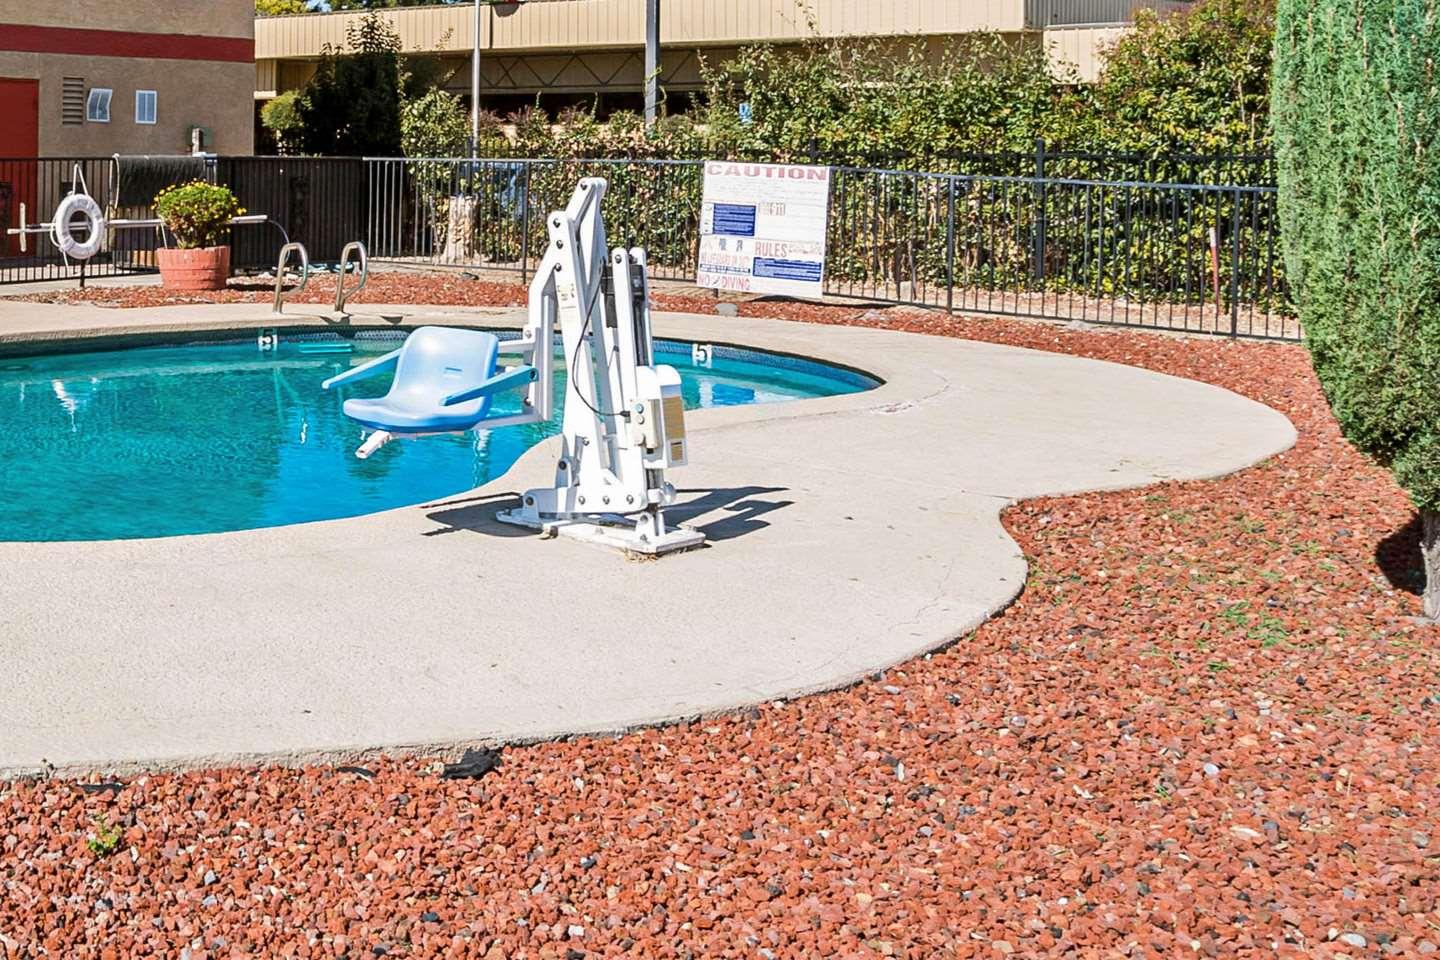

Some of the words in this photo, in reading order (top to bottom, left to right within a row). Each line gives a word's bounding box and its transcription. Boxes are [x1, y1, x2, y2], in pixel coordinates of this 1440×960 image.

[707, 164, 827, 181] CAUTION
[755, 241, 788, 258] RULES
[721, 276, 751, 291] DIVING
[262, 329, 274, 345] 5
[696, 344, 708, 364] 5
